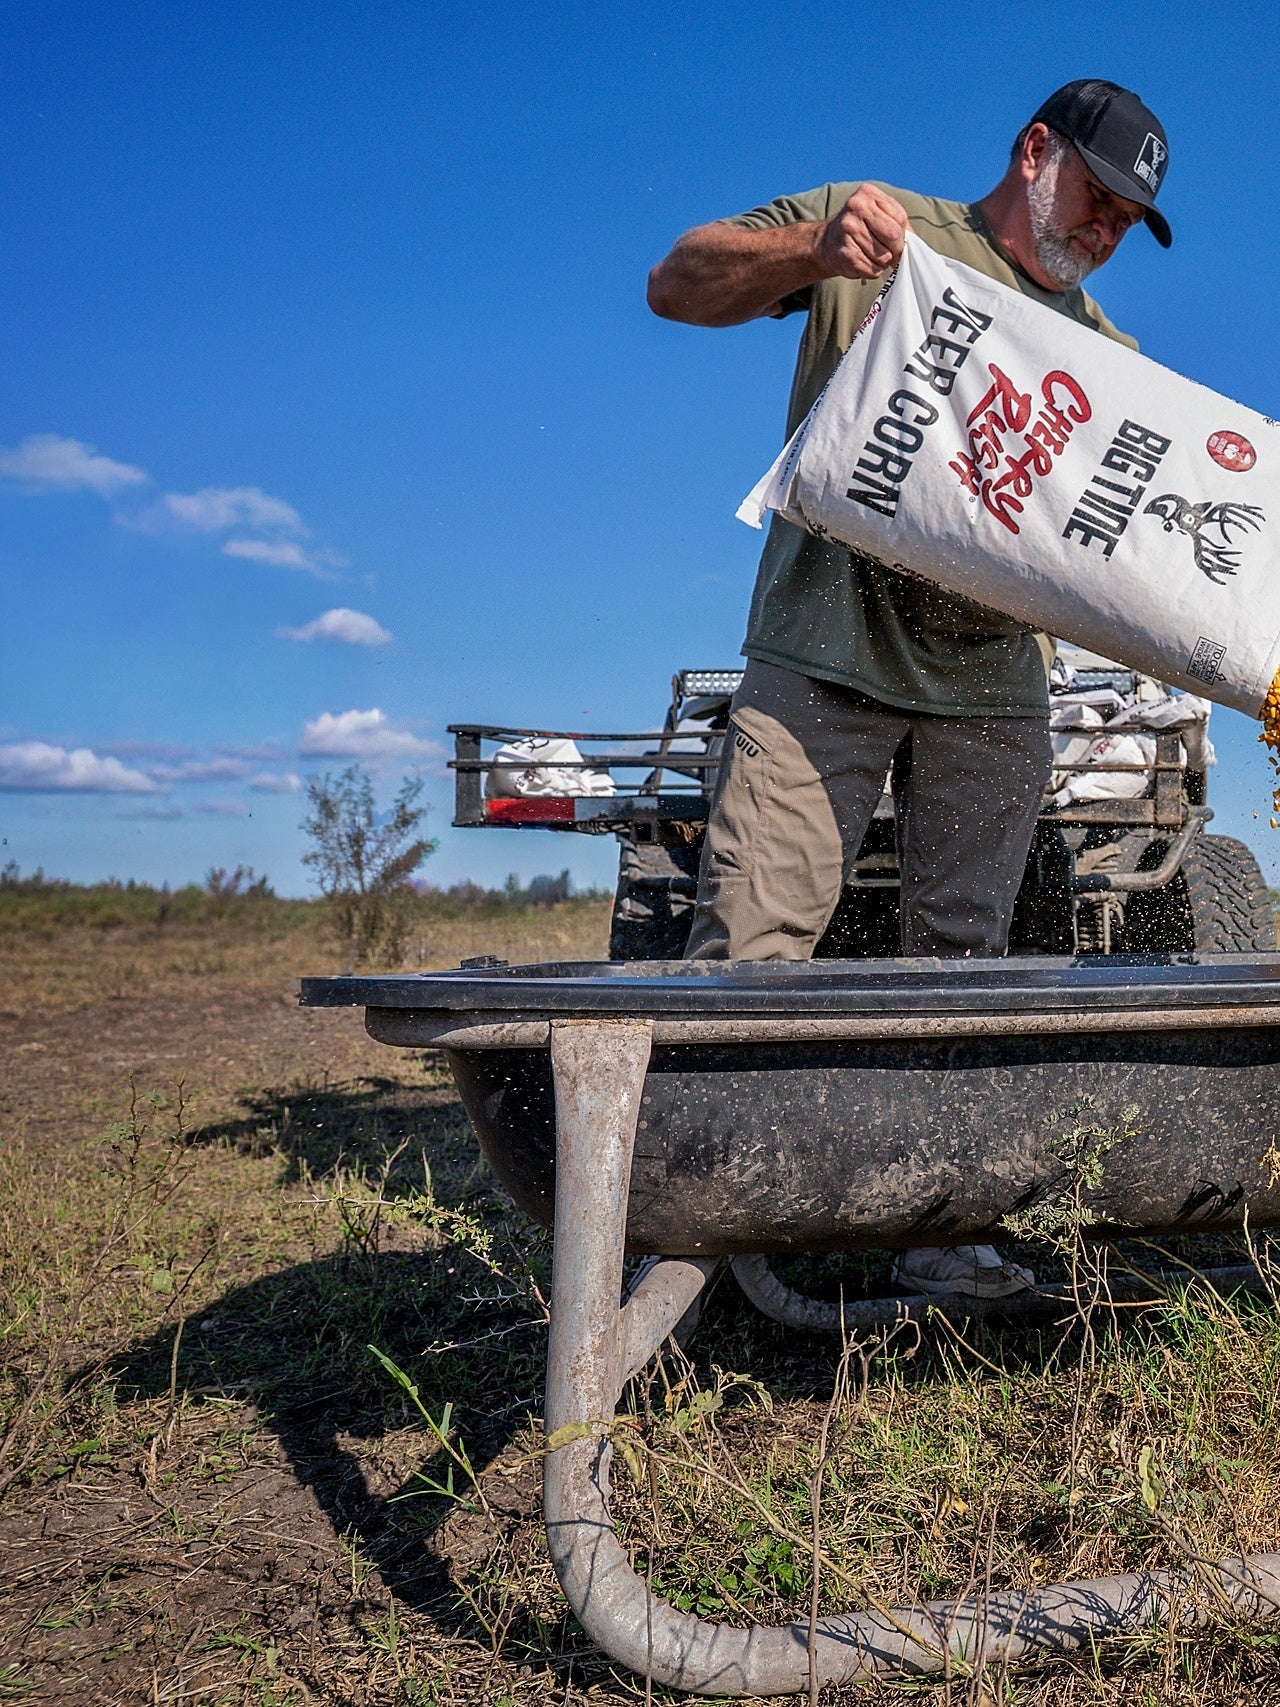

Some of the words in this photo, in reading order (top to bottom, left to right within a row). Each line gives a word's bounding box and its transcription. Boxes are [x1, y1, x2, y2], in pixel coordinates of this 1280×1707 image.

[903, 286, 994, 396] DEER
[846, 389, 939, 518] CORN
[1100, 418, 1172, 483] BIG
[1062, 475, 1147, 557] TINE
[1195, 641, 1207, 659] WIDE
[1212, 648, 1224, 660] TO
[1189, 659, 1199, 675] TAPE
[1203, 659, 1218, 682] OPEN
[736, 732, 759, 757] UIU
